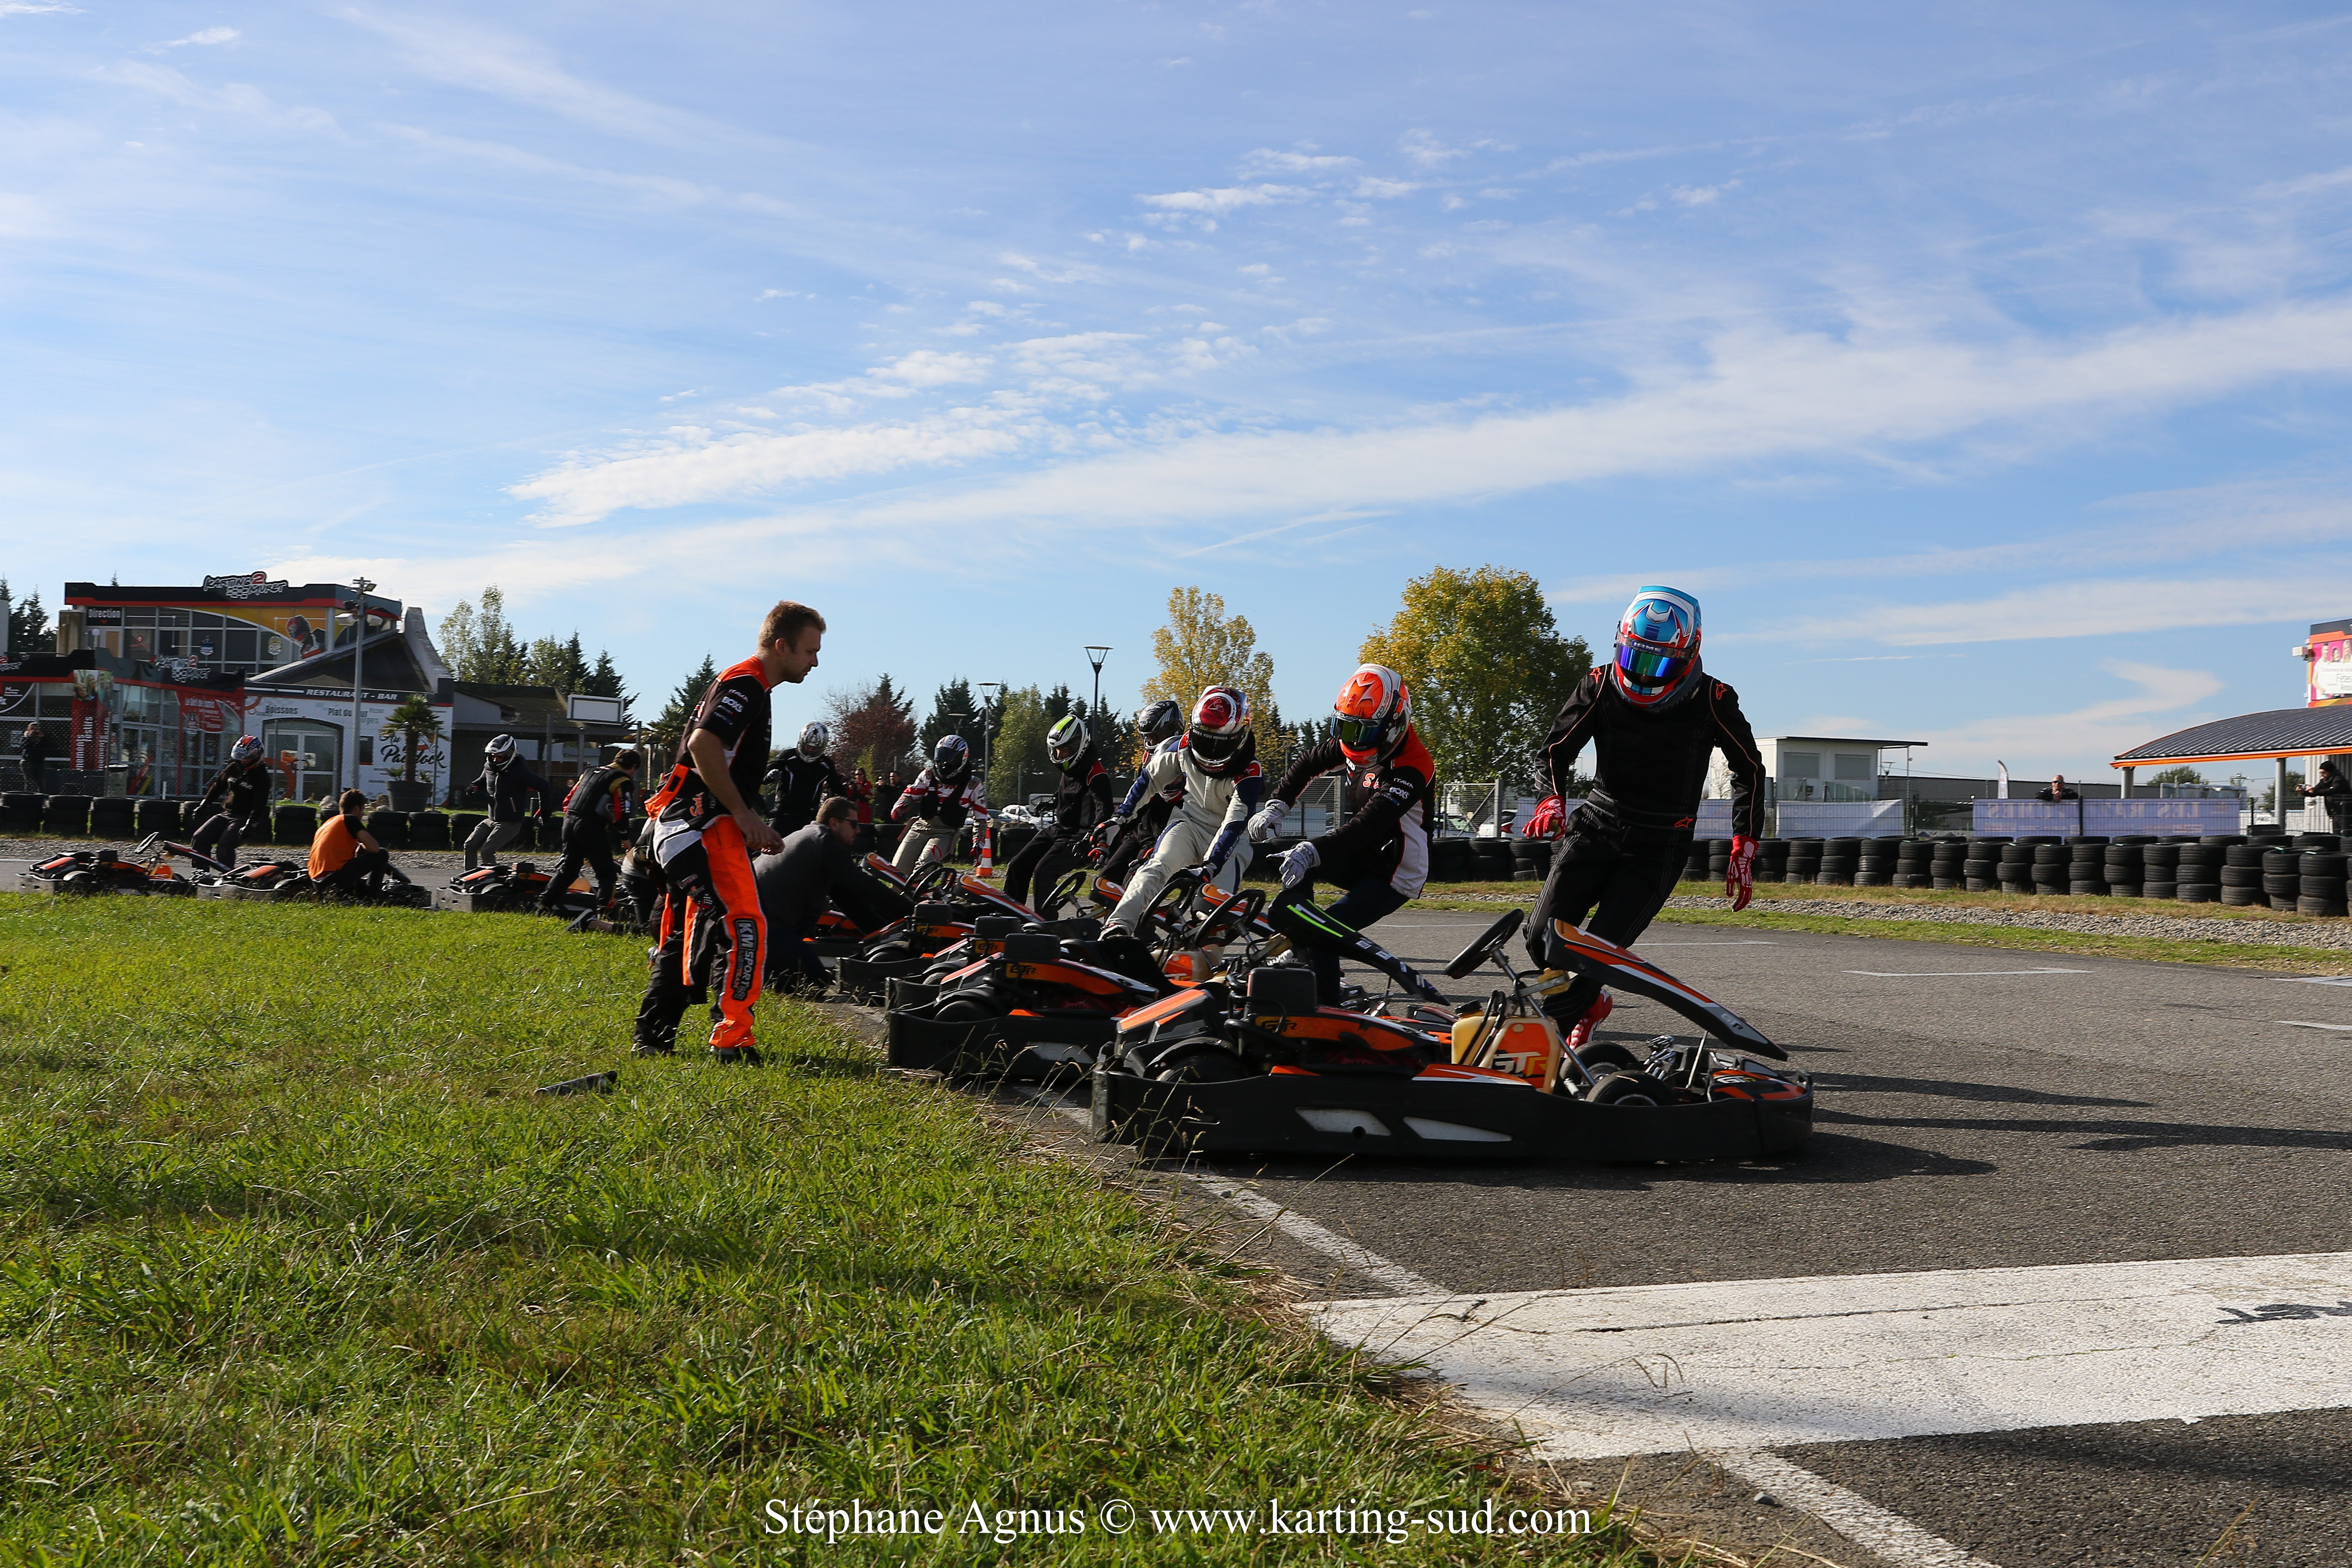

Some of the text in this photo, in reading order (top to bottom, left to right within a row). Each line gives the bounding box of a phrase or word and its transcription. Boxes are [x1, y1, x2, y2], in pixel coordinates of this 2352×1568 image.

[203, 573, 266, 591] KARTING 2
[247, 582, 287, 595] MURET
[88, 608, 121, 618] Direction
[1633, 642, 1663, 653] IAME
[189, 655, 198, 668] 2
[728, 689, 749, 702] ITAKA
[265, 704, 298, 714] Boissons
[328, 707, 341, 717] Plat
[1377, 706, 1385, 718] KM
[1393, 778, 1414, 789] ITAKA
[1389, 786, 1410, 799] BOXS
[738, 922, 754, 988] KM SPORT
[732, 968, 742, 989] TEAM
[1491, 1051, 1549, 1077] GTR
